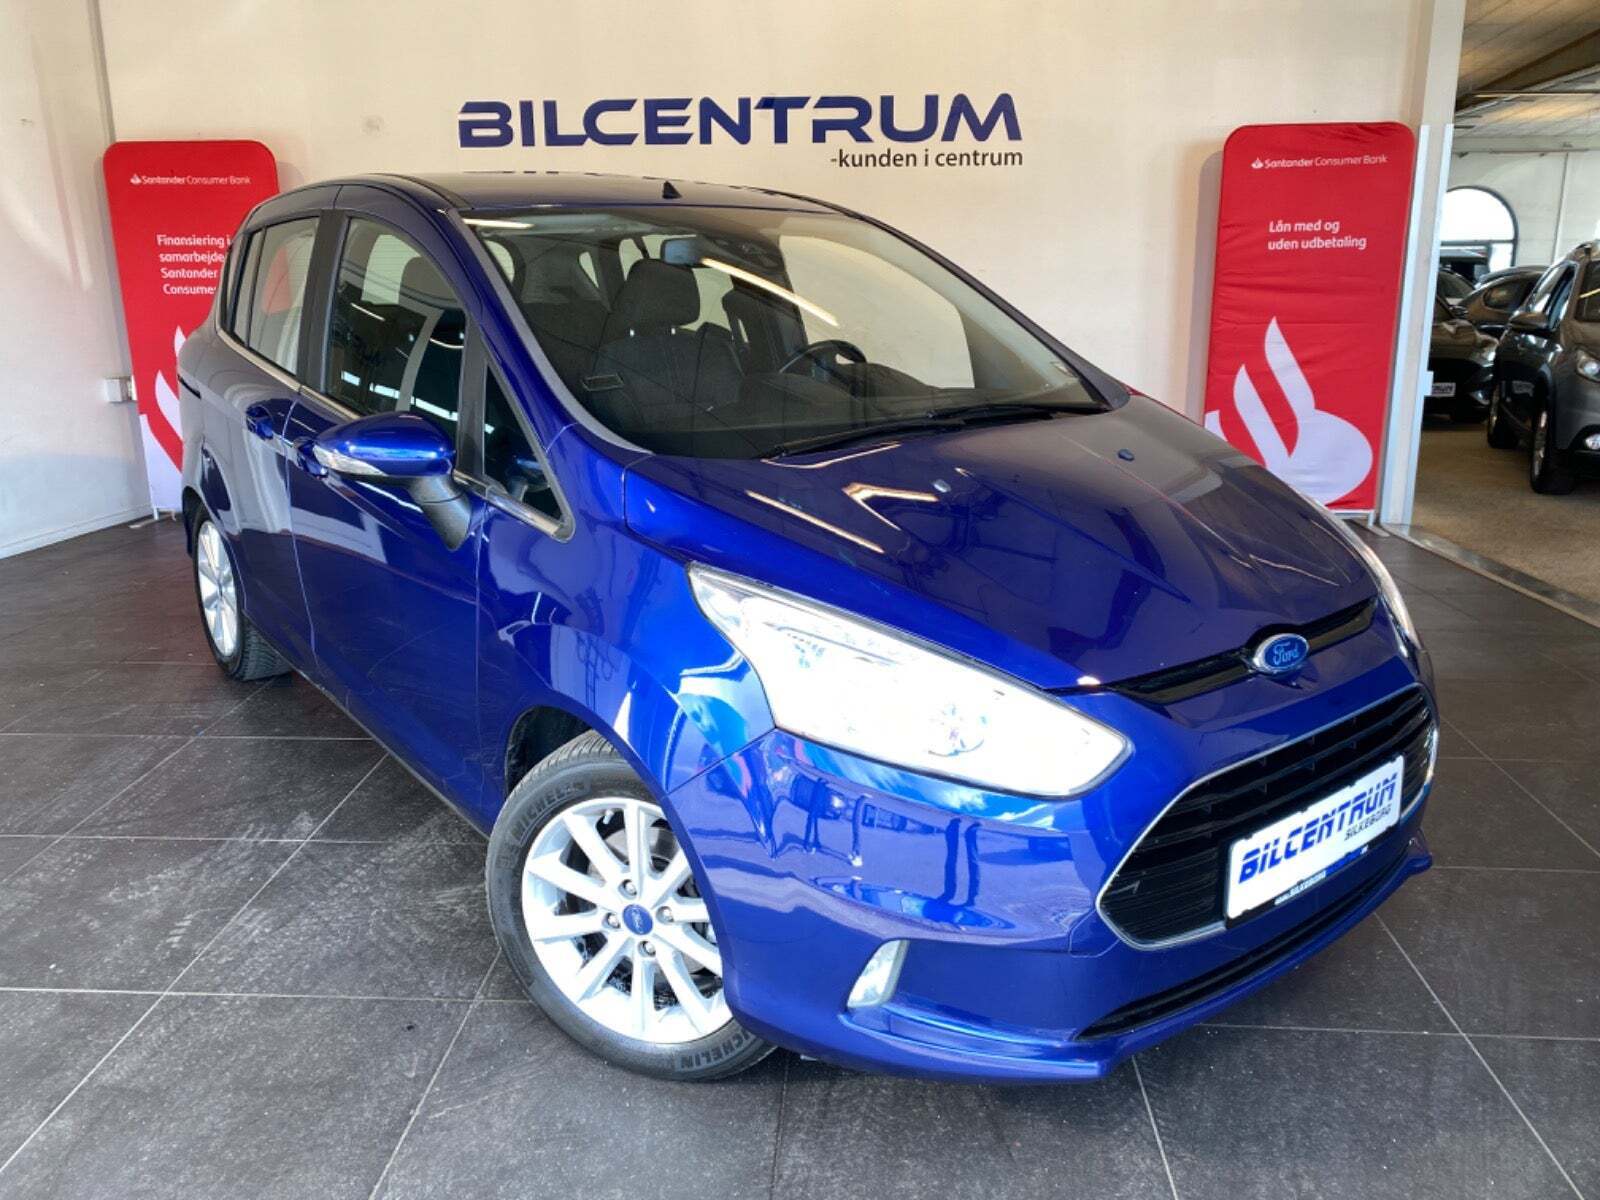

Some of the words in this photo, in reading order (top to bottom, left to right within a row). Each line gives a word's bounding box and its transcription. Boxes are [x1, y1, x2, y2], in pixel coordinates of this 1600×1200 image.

[458, 93, 1023, 148] BILCENTRUM
[830, 148, 917, 168] -kunden
[924, 148, 929, 167] i
[934, 150, 1023, 167] centrum
[1264, 158, 1313, 168] Santander
[1314, 156, 1362, 167] Consumer
[1363, 154, 1388, 164] Bank
[142, 175, 185, 185] Santander
[186, 175, 229, 185] Consumer
[230, 175, 251, 185] Bank
[1269, 220, 1291, 233] Lån
[1294, 219, 1322, 232] med
[1323, 221, 1340, 236] og
[156, 234, 225, 249] Finansiering
[1268, 237, 1298, 250] uden
[1301, 235, 1367, 250] udbetaling
[159, 251, 225, 265] samarbejde
[160, 267, 217, 279] Santander
[1273, 641, 1299, 665] Ford
[1238, 772, 1397, 884] BILCENTRUM
[679, 1026, 755, 1071] ICHELIN
